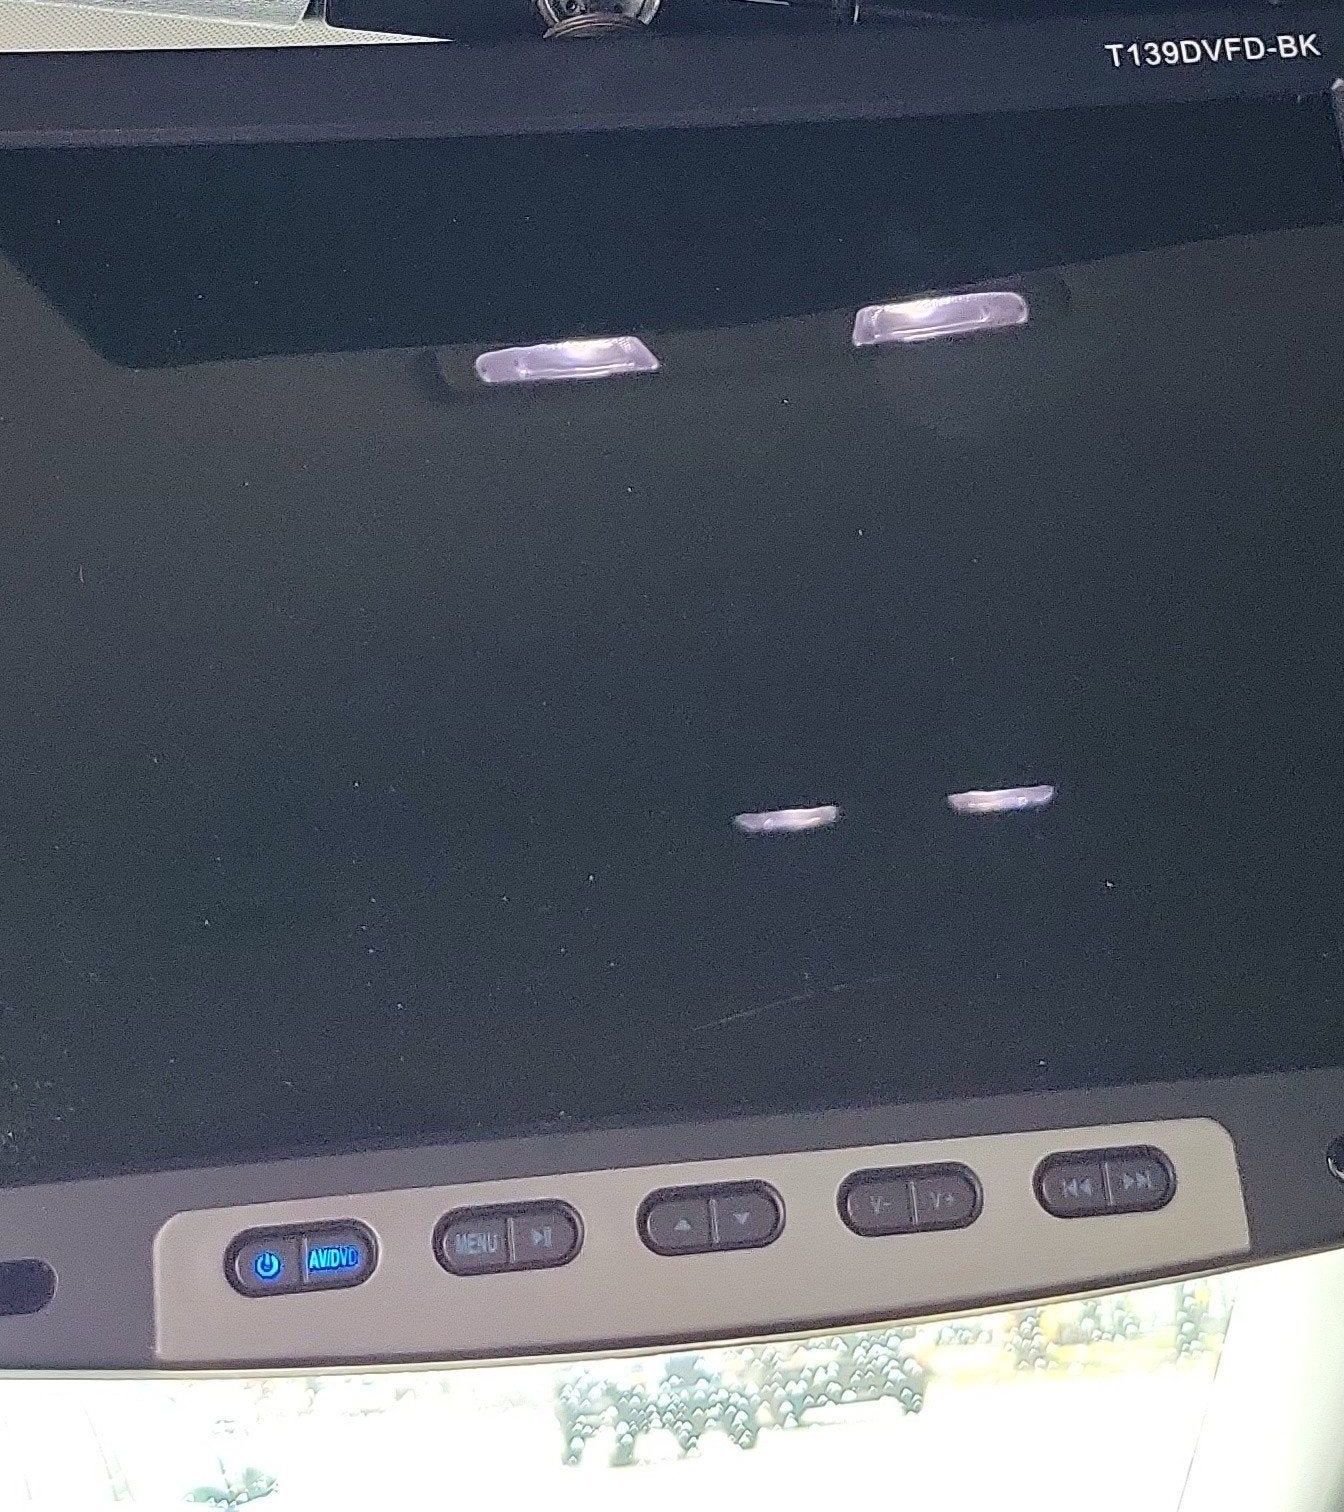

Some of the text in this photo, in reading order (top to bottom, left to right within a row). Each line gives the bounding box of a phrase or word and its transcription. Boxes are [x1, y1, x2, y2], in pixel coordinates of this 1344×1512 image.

[1104, 33, 1322, 68] T139DVFD-BK
[454, 1231, 499, 1255] MENU
[308, 1246, 359, 1269] AV/DVD
